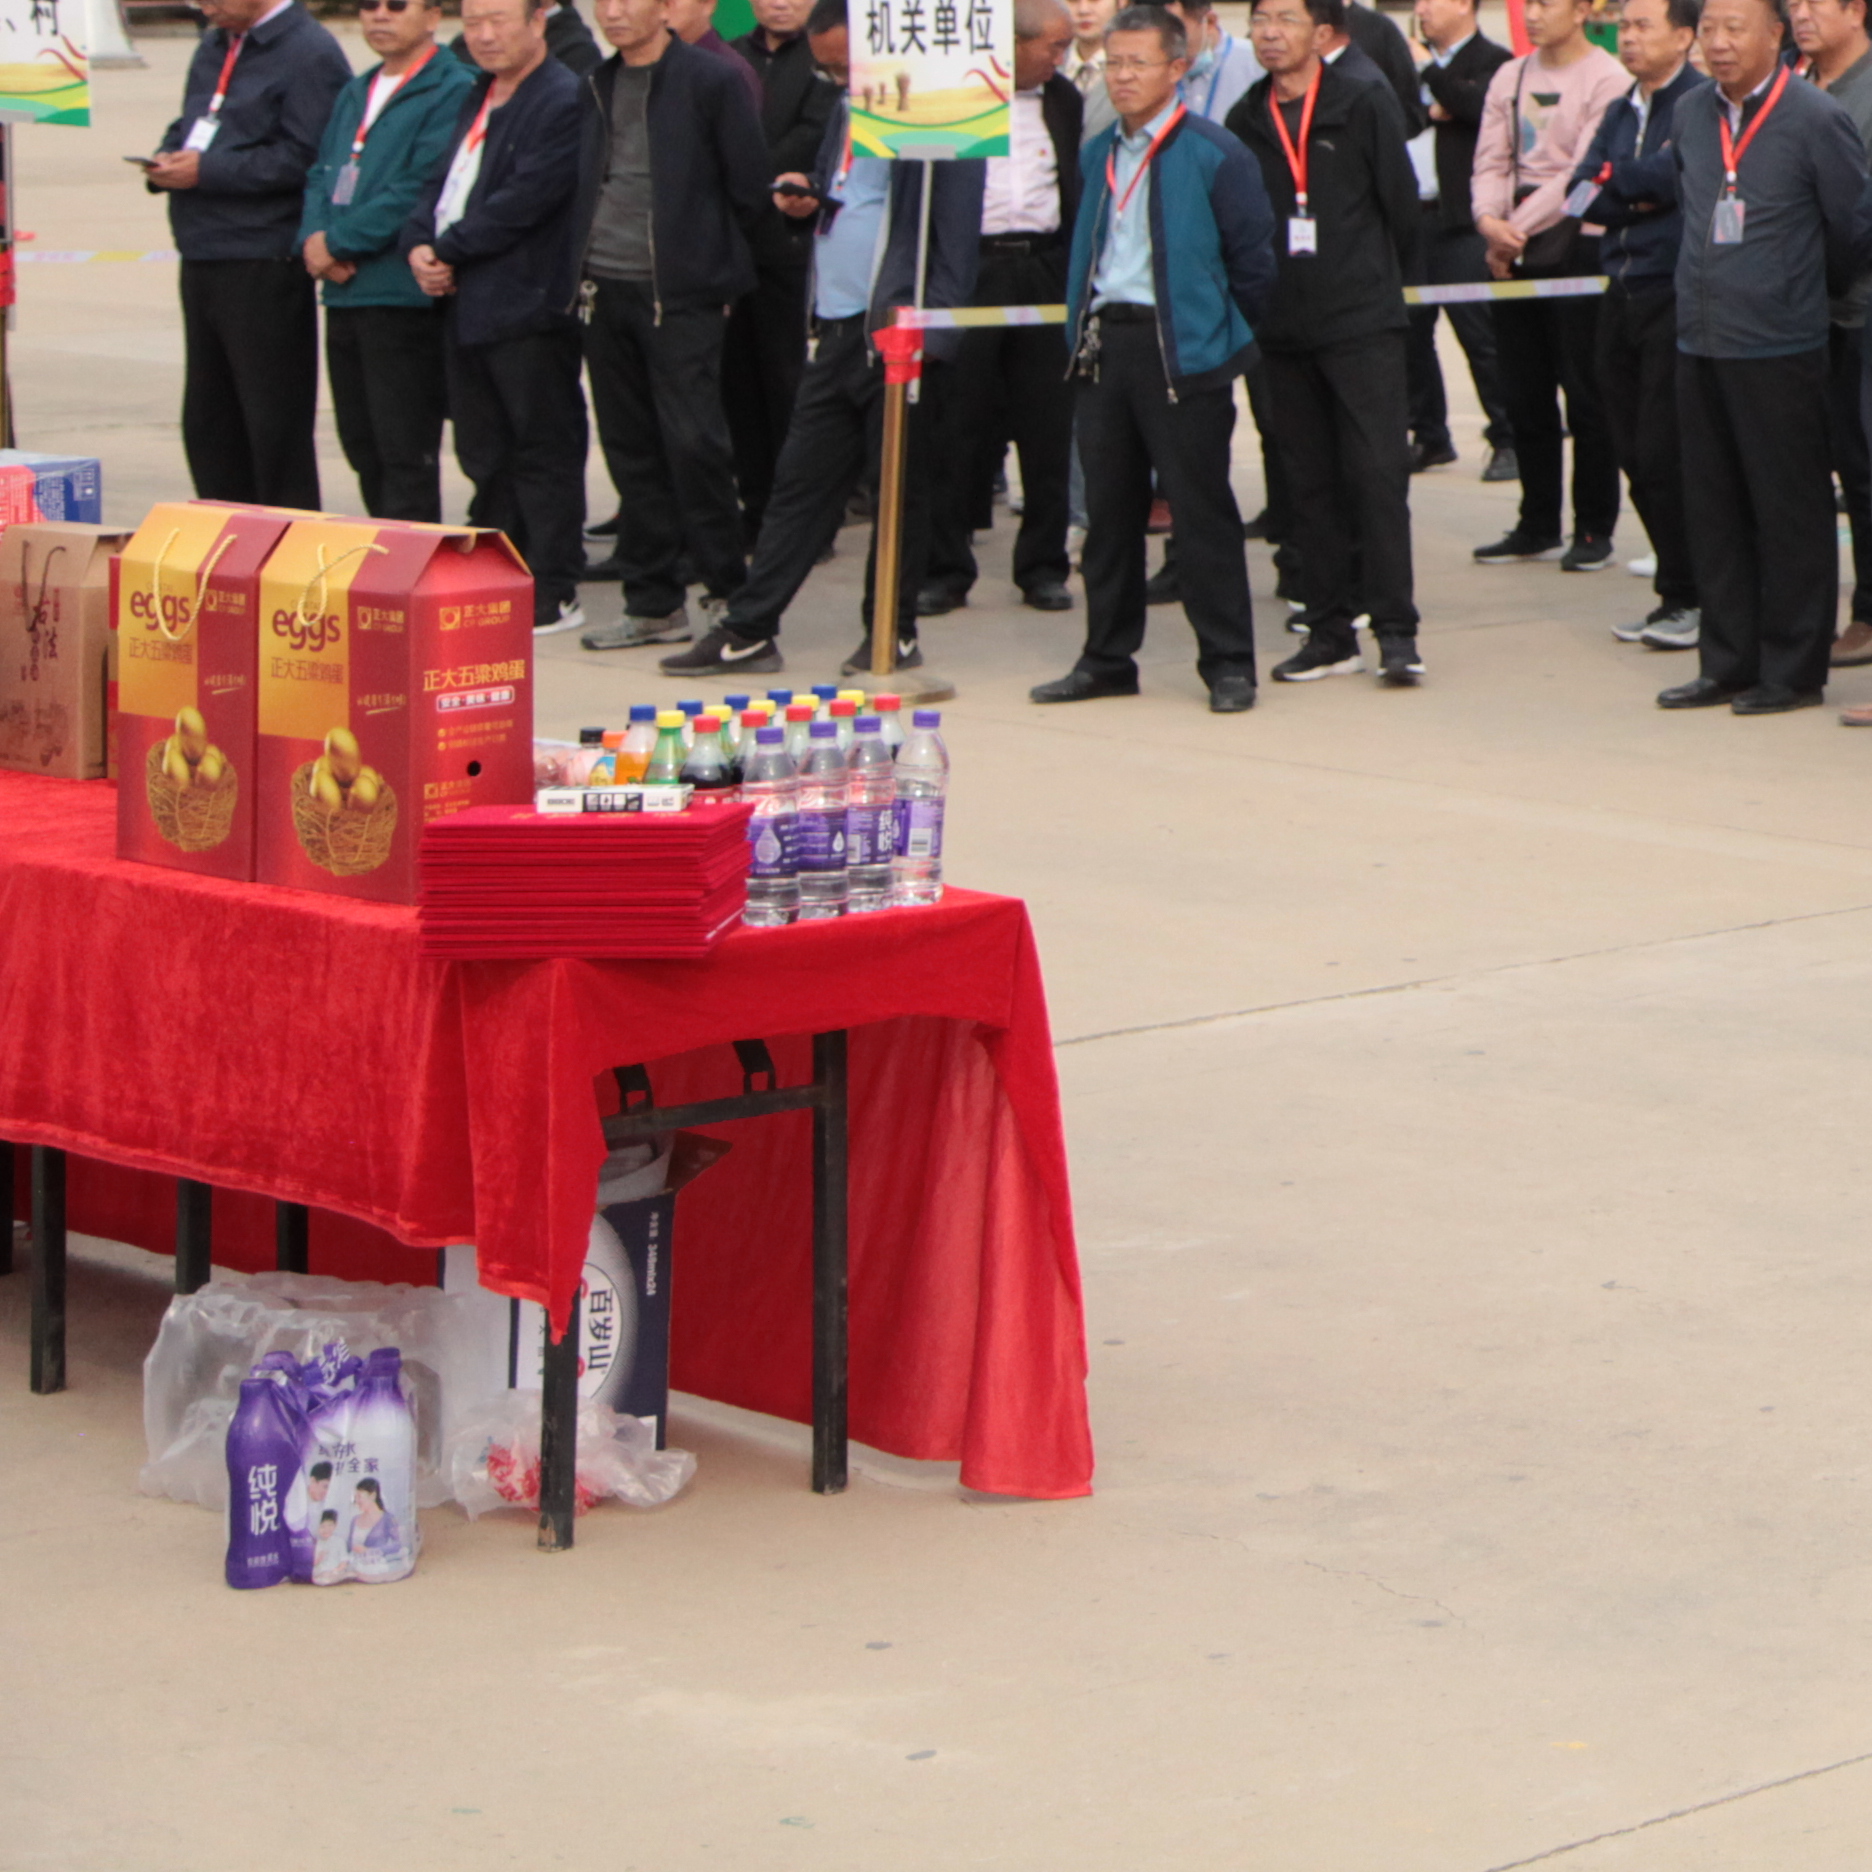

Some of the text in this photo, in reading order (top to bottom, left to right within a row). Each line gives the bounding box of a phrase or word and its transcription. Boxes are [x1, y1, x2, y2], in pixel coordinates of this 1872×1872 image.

[131, 590, 191, 631] eggs
[272, 608, 341, 652] eggs
[588, 1288, 614, 1371] 百岁山
[248, 1464, 280, 1536] 纯悦
